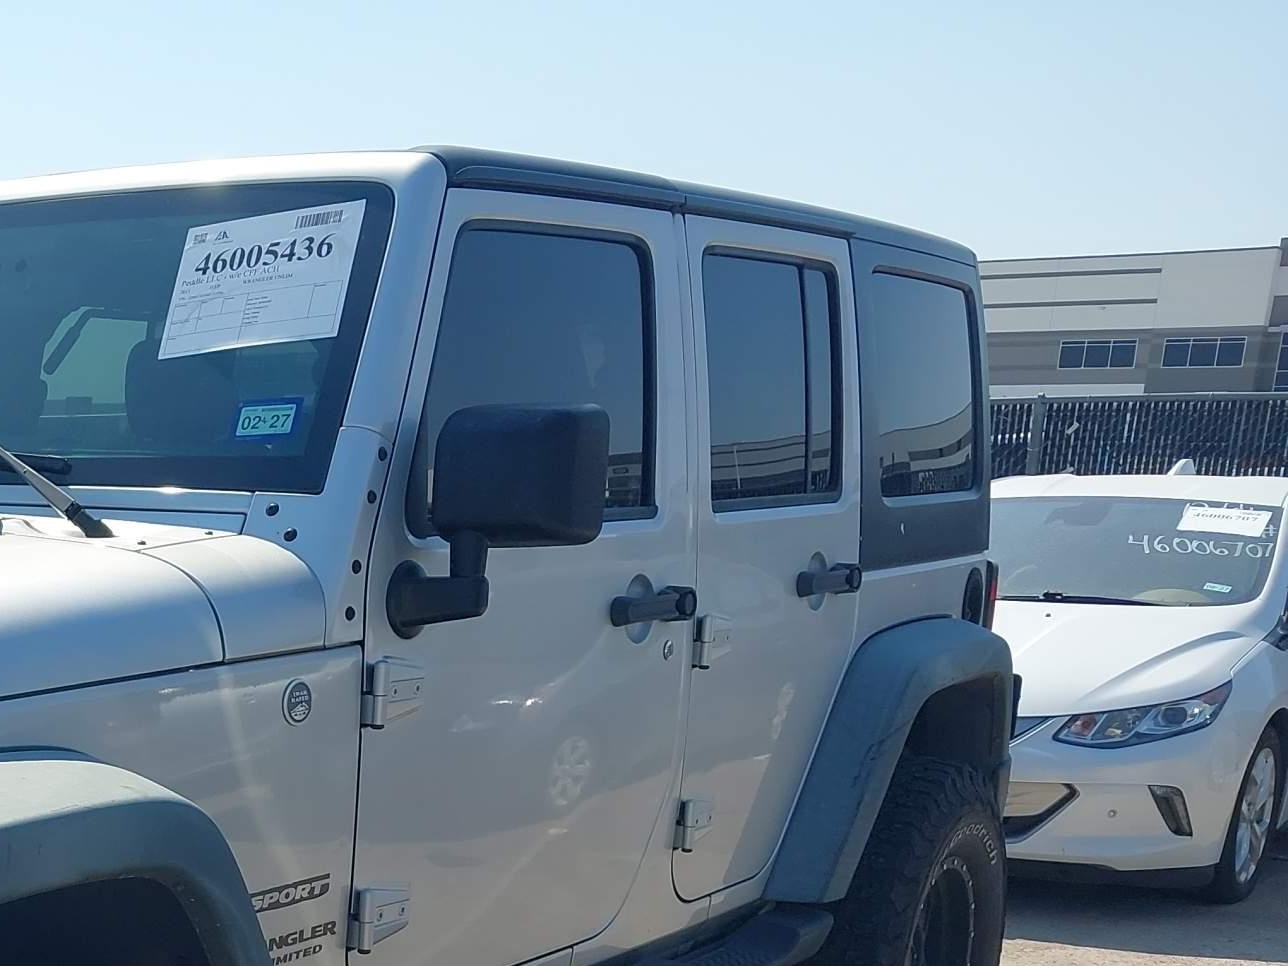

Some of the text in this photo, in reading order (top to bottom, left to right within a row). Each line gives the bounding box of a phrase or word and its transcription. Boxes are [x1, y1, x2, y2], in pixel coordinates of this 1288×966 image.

[194, 233, 335, 275] 46005436
[241, 414, 292, 430] 02 27
[1127, 534, 1275, 558] 46006707
[252, 880, 329, 910] SPORT
[268, 920, 336, 952] NGLER
